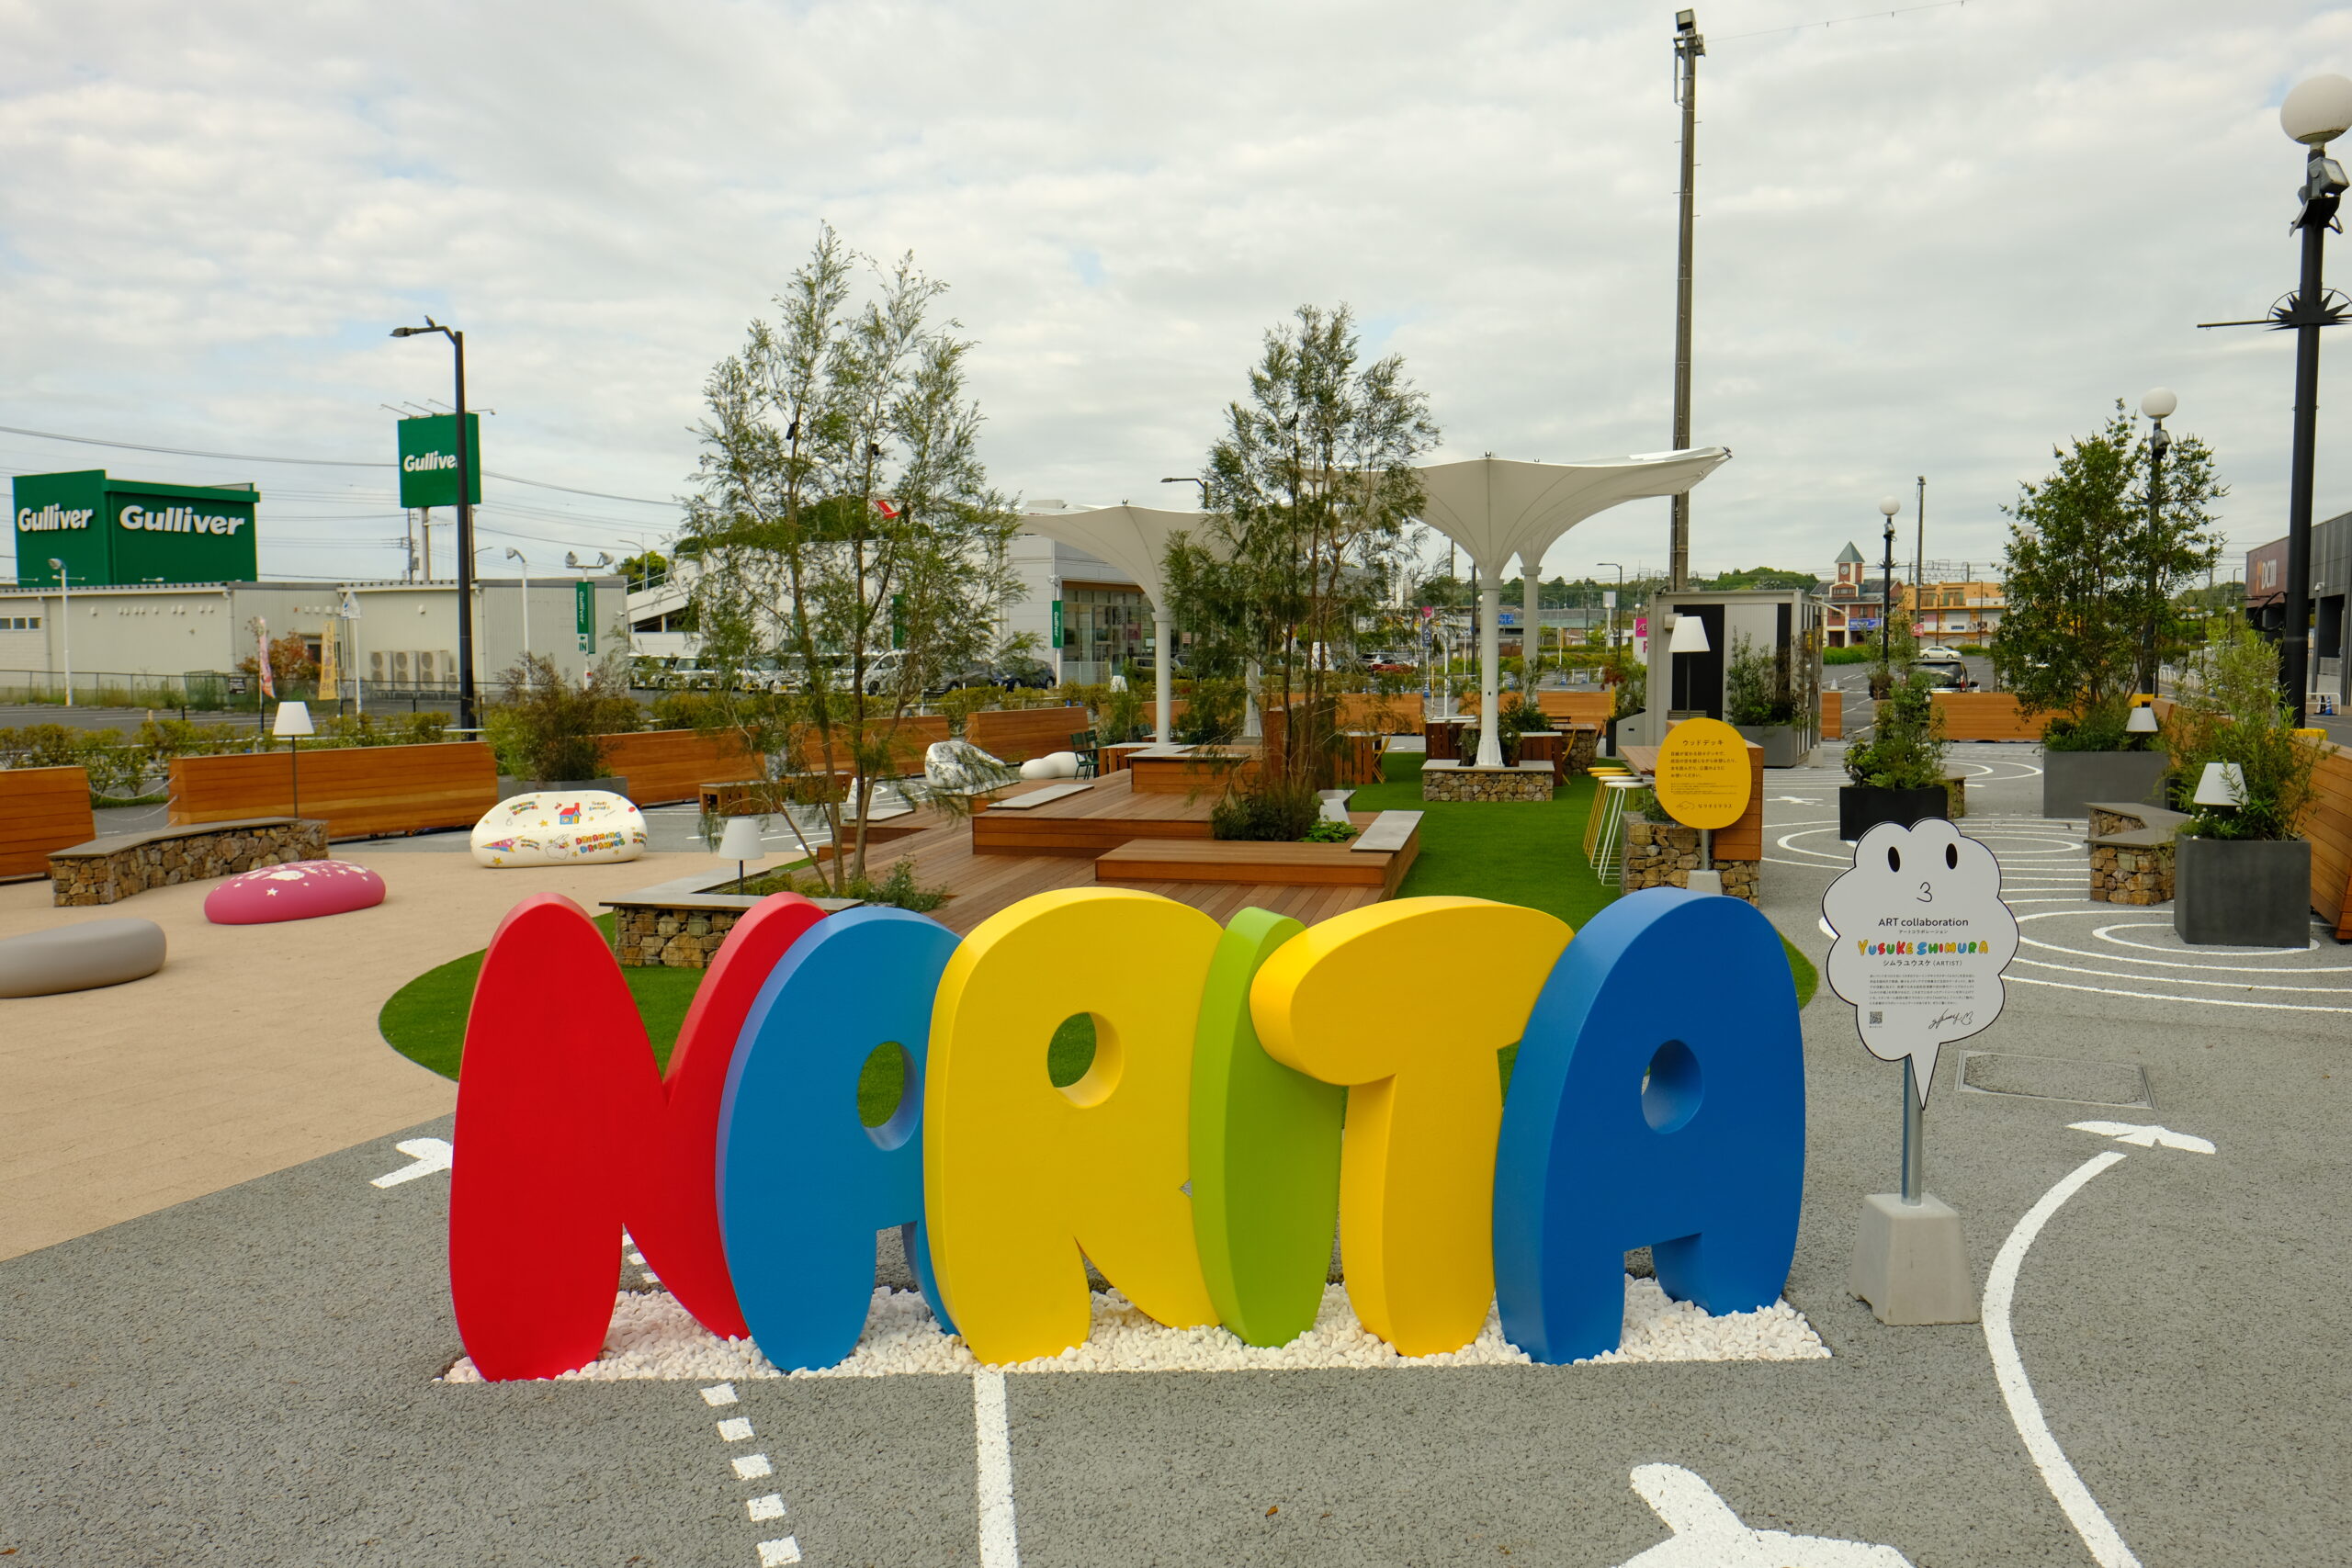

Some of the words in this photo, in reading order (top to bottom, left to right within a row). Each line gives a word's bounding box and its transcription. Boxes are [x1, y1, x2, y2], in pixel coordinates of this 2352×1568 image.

[403, 450, 458, 472] Gullive
[17, 503, 93, 532] Gulliver
[119, 505, 244, 535] Gulliver
[579, 642, 587, 651] IN
[1878, 918, 1899, 927] ART
[1901, 918, 1969, 927] collaboration
[1857, 939, 1914, 956] YUSUKE
[1917, 940, 1989, 955] SHIMURA
[1883, 959, 1931, 967] シムラユウスケ
[449, 887, 1807, 1383] NARITA
